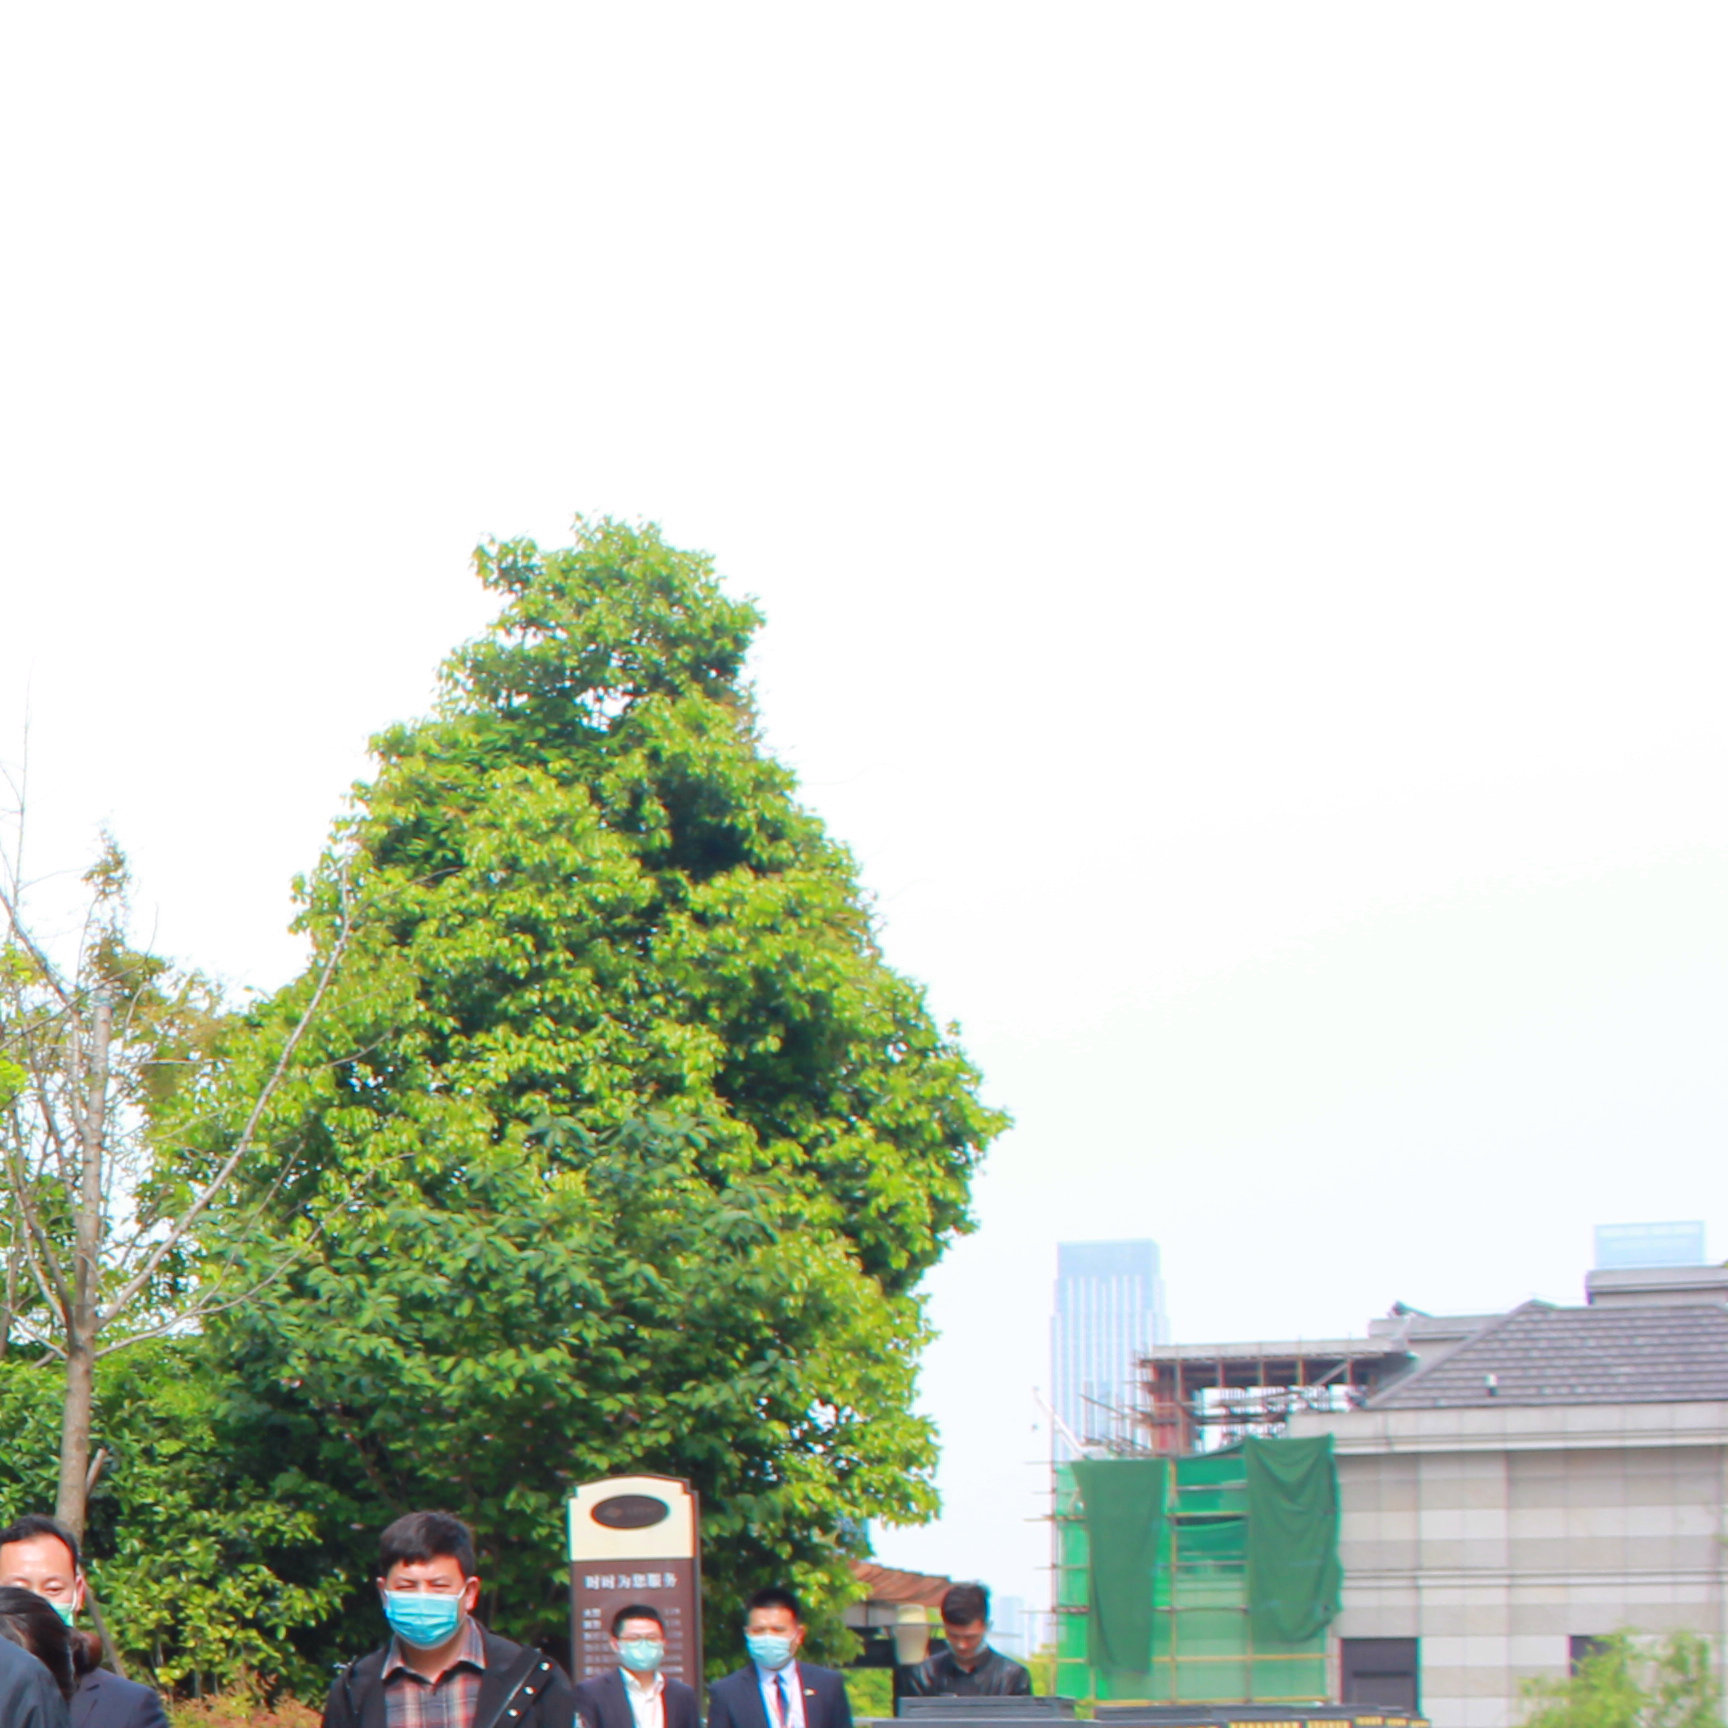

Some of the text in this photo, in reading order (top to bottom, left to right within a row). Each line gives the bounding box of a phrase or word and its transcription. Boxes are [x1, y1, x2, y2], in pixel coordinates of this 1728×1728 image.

[584, 1572, 678, 1590] 时时为您服务
